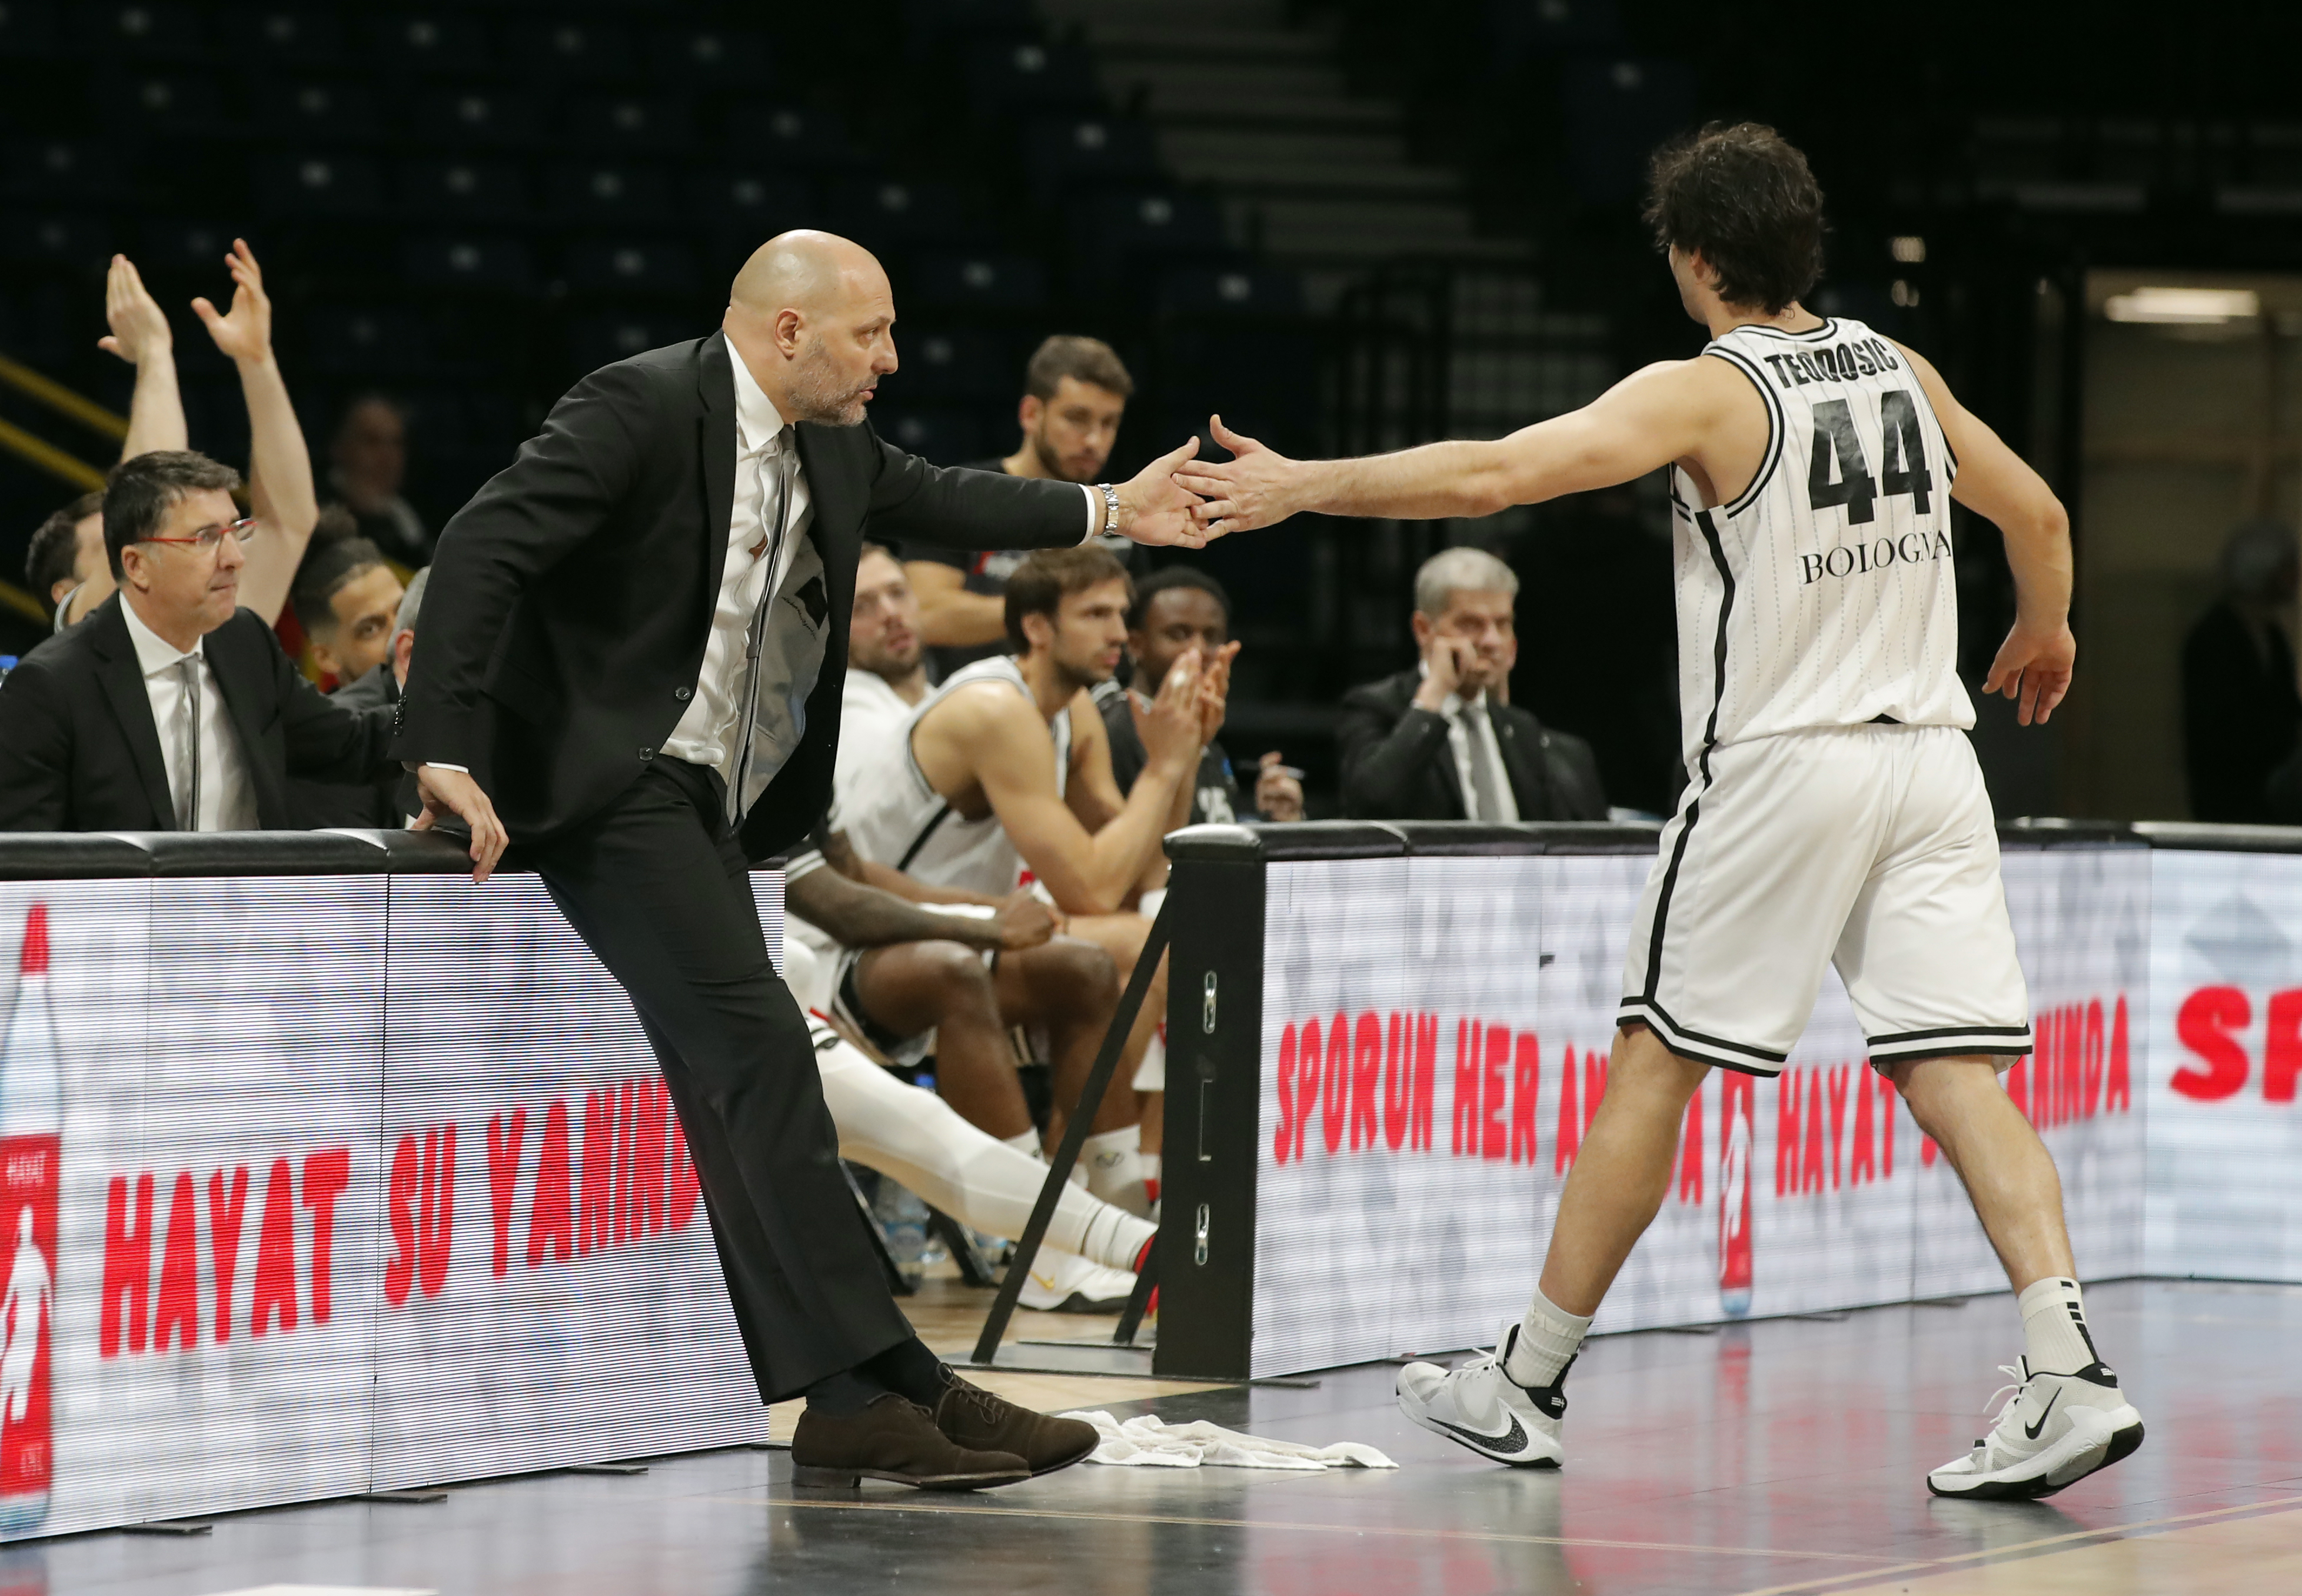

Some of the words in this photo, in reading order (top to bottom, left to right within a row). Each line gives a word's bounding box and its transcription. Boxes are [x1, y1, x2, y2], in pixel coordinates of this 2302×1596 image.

[1764, 337, 1899, 388] TEODOSIC
[1808, 390, 1932, 526] 44
[1800, 530, 1952, 584] BOLOGNA
[1273, 1008, 1439, 1167] SPORUN
[1451, 1017, 1541, 1167] HER
[1774, 1059, 1897, 1198] HAYAT
[2005, 993, 2131, 1135] ANINDA
[99, 1146, 351, 1360] HAYAT
[383, 1122, 457, 1309] SU
